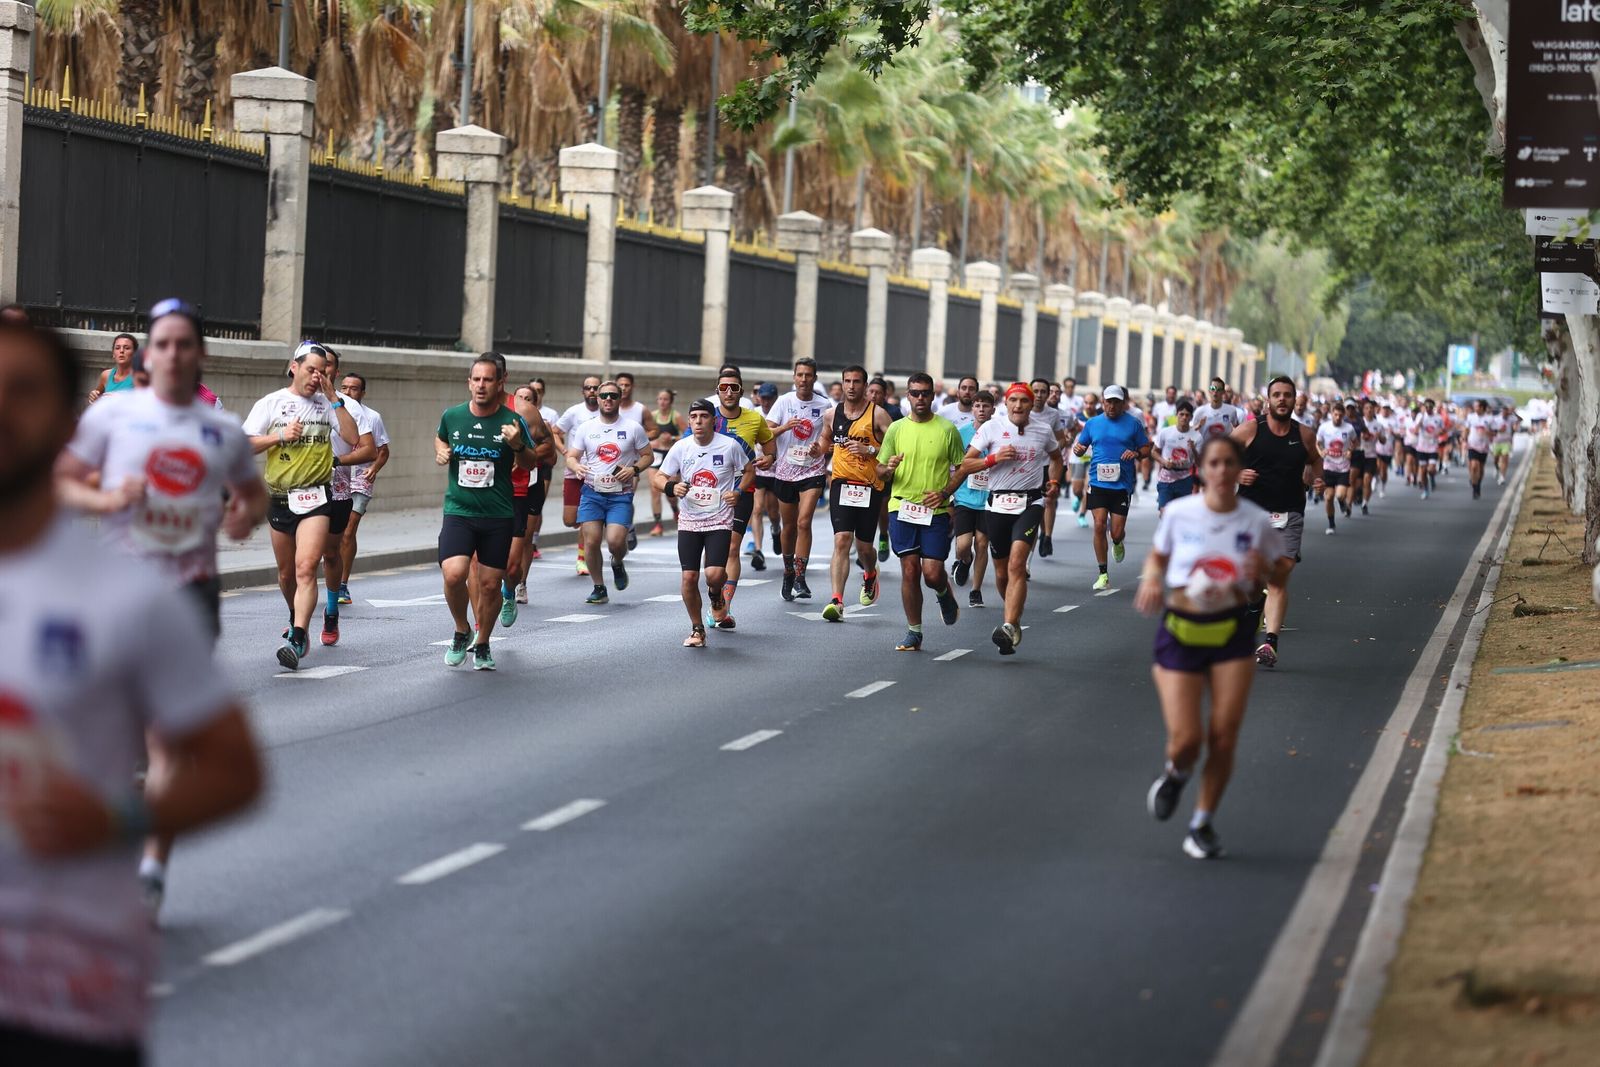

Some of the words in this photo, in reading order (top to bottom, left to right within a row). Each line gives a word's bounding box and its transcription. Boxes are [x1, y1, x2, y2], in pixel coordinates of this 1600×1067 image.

[465, 467, 487, 476] 682
[297, 492, 319, 501] 665
[694, 492, 713, 501] 927
[847, 490, 864, 498] 652
[905, 504, 929, 514] 1011
